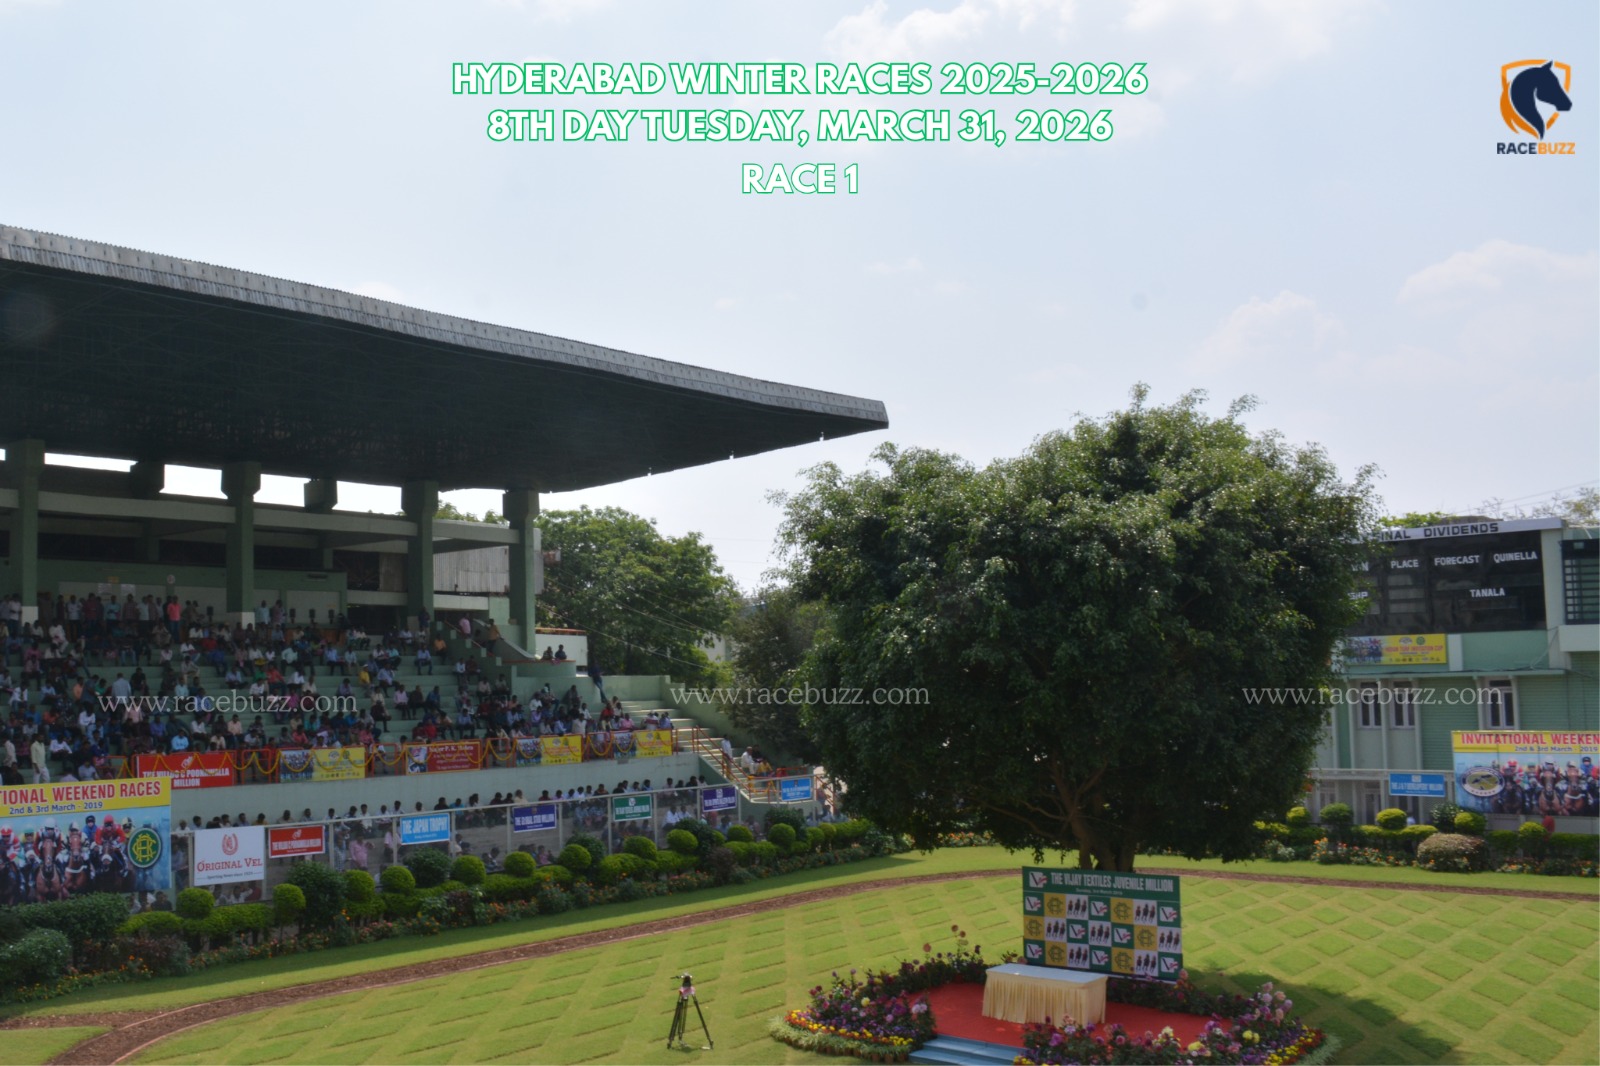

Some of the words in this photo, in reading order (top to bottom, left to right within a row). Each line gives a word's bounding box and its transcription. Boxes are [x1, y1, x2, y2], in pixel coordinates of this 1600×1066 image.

[1379, 529, 1411, 541] INAL
[1423, 522, 1499, 537] DIVIDENDS
[1390, 559, 1419, 569] PLACE
[1434, 554, 1480, 566] FORECAST
[1493, 551, 1538, 563] QUINELLA
[1469, 587, 1506, 598] TANALA
[1461, 733, 1547, 745] INVITATIONAL
[173, 778, 200, 787] MILLION
[0, 788, 48, 805] IONAL
[53, 784, 115, 802] WEEKEND
[120, 781, 161, 798] RACES
[10, 806, 25, 814] 2nd
[36, 804, 49, 813] 3rd
[51, 803, 76, 812] March
[84, 801, 103, 810] 2019
[244, 857, 263, 867] VEL
[1051, 872, 1063, 885] THE
[1063, 873, 1082, 886] VIJAY
[1083, 874, 1112, 889] TEXTILES
[1112, 876, 1144, 891] JUVENILE
[1145, 878, 1174, 893] MILLION
